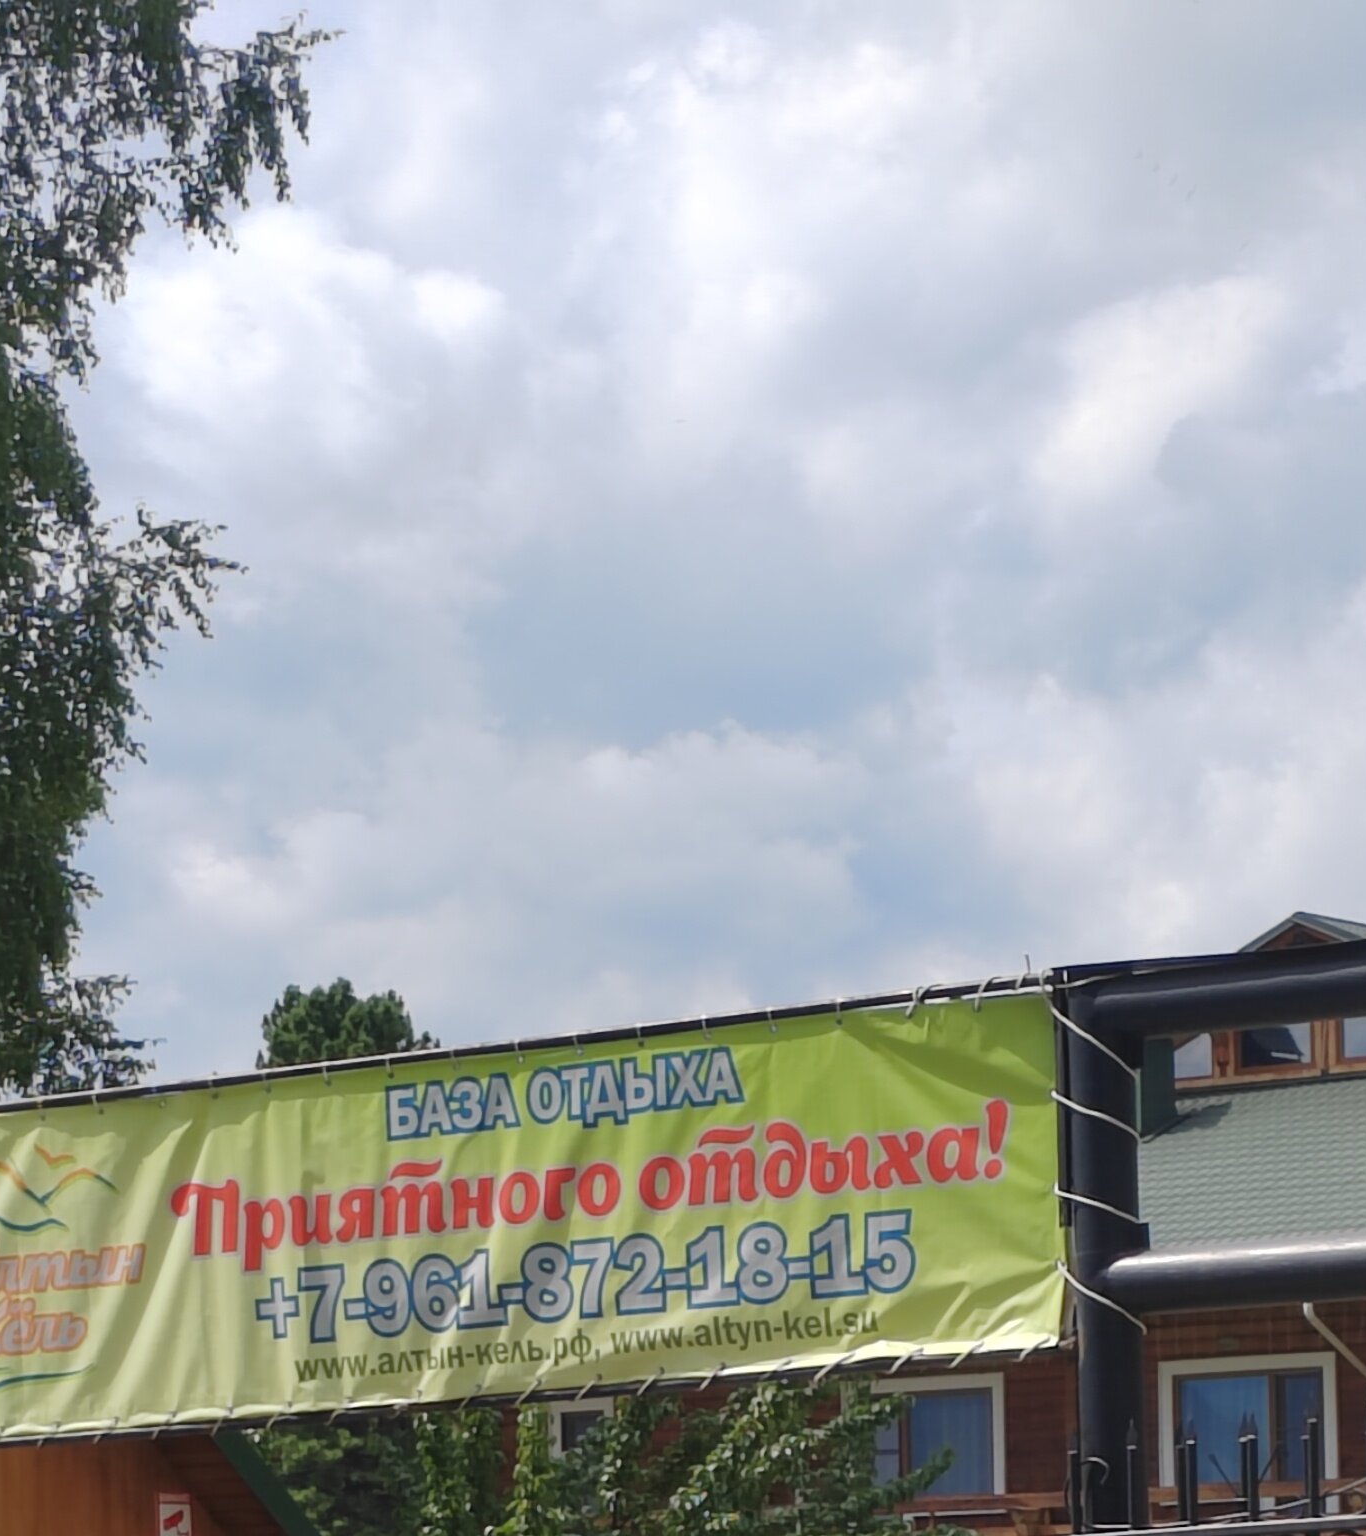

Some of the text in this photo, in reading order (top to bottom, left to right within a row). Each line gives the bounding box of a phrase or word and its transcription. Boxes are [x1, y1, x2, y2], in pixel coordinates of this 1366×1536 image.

[386, 1046, 744, 1141] БАЗА ОТДЫХА
[170, 1099, 1010, 1272] Приятного отдыха!
[256, 1209, 916, 1343] +7-961-872-18-15
[611, 1306, 879, 1354] www.altyn-kel.su
